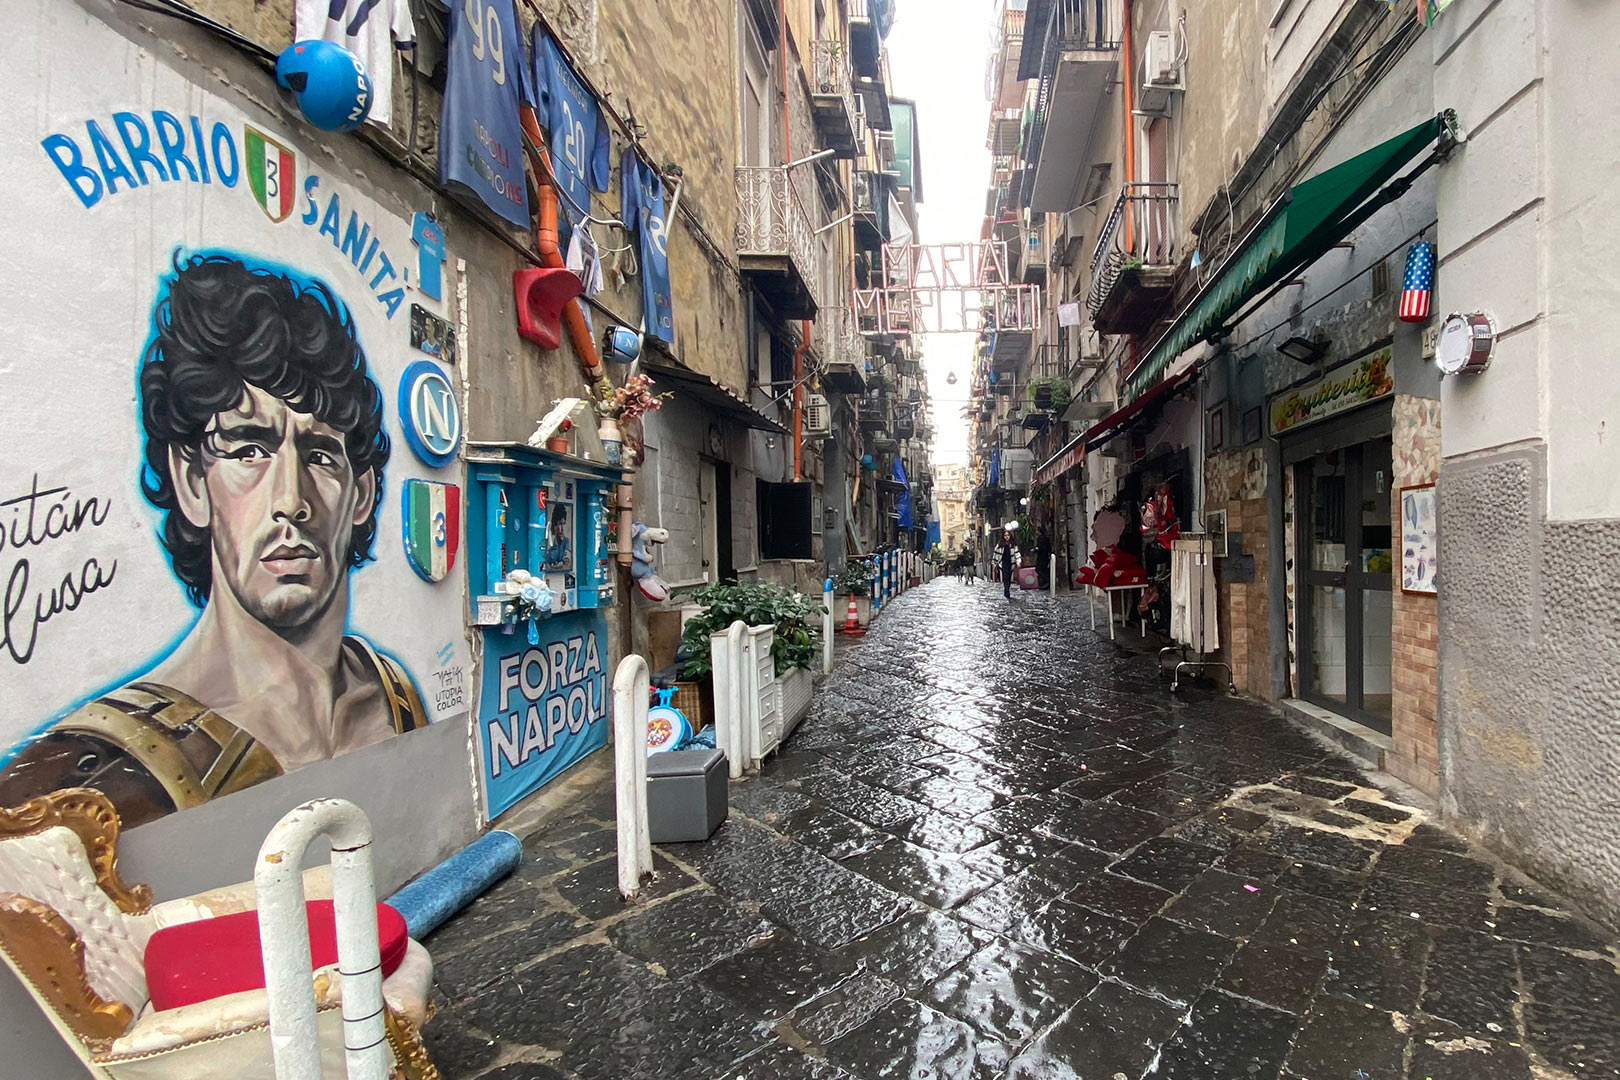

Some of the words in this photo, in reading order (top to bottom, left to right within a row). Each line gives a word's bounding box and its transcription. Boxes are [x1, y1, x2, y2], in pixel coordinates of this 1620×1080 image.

[465, 0, 504, 85] 99
[40, 110, 240, 209] BARRIO
[563, 100, 584, 180] 20
[265, 160, 279, 198] 3
[642, 206, 667, 257] 18
[881, 242, 1006, 289] MARIA
[625, 339, 634, 348] N
[1424, 330, 1438, 350] 48
[422, 382, 453, 442] N
[1286, 367, 1374, 418] Frutteria
[432, 511, 446, 547] 3
[0, 558, 118, 665] lusa
[435, 686, 463, 702] UTOPIA
[498, 631, 601, 714] FORZA
[436, 696, 464, 712] COLOR
[488, 674, 608, 779] NAPOLI
